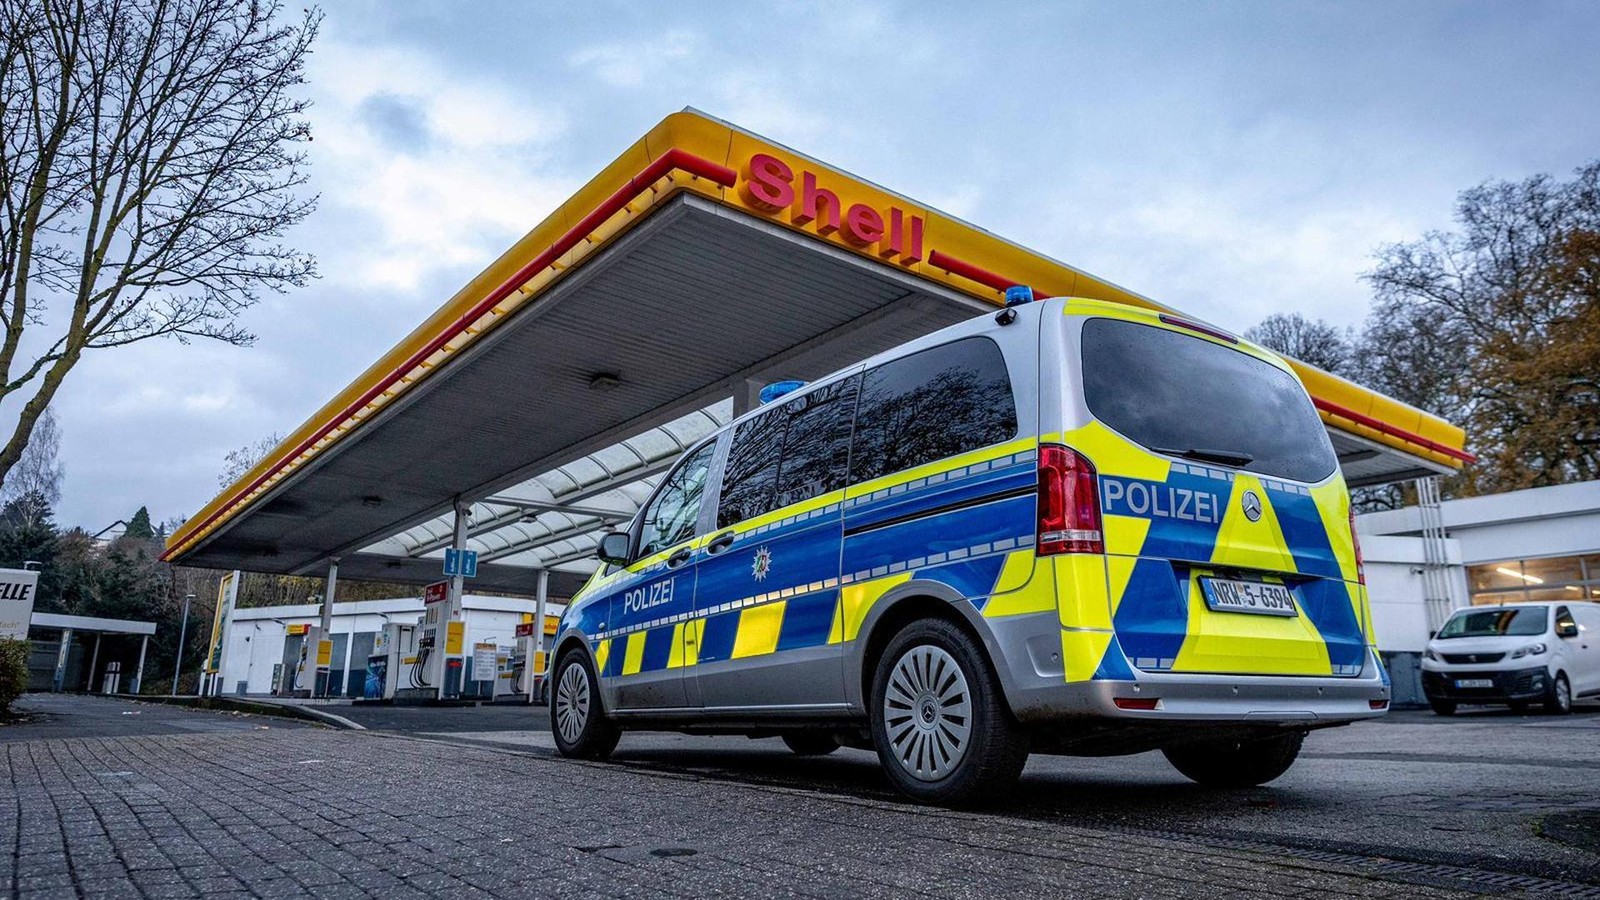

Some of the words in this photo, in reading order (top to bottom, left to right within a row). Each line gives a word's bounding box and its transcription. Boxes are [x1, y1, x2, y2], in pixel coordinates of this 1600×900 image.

[746, 153, 924, 265] Shell
[1103, 479, 1219, 524] POLIZEI
[623, 578, 675, 615] POLIZEI
[1211, 582, 1242, 606] NRW
[1244, 585, 1293, 610] 5-6394
